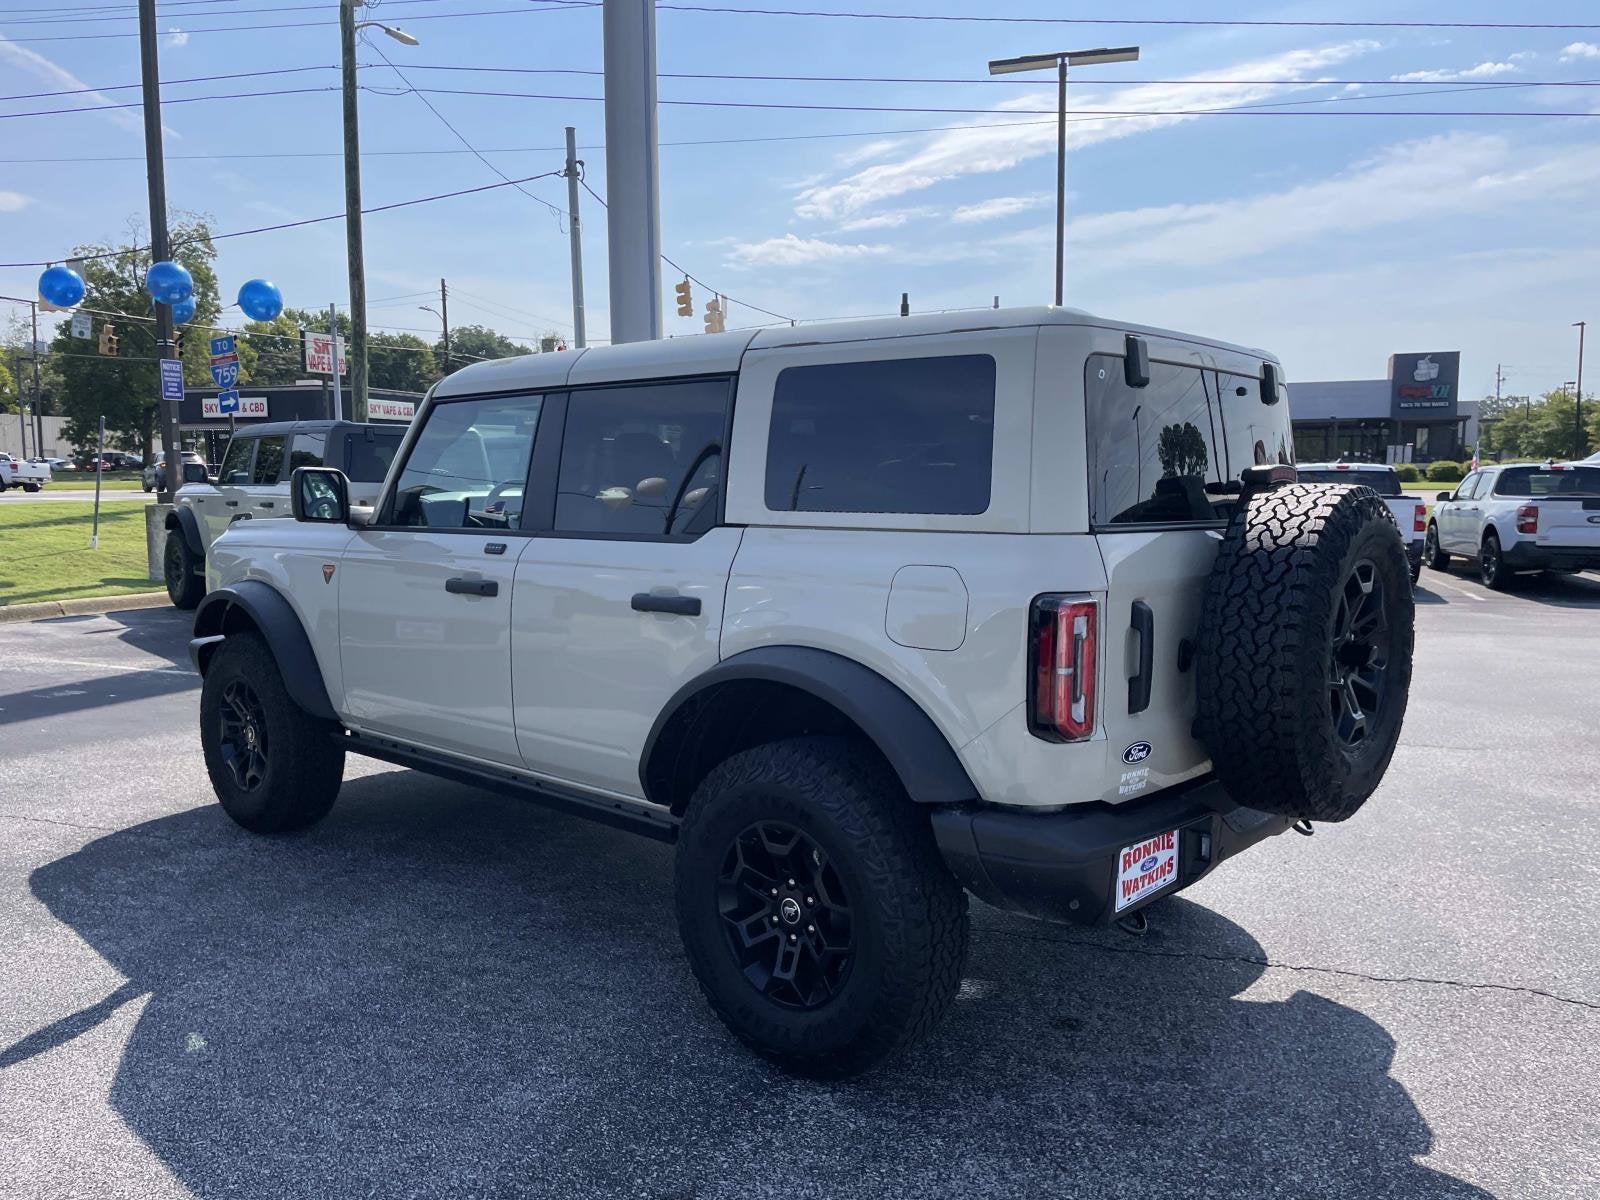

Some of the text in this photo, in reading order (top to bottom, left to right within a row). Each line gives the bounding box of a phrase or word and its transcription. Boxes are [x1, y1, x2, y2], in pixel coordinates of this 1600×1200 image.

[216, 340, 228, 351] TO
[162, 363, 181, 371] NOTICE
[307, 354, 326, 371] VAPE
[215, 366, 237, 384] 759
[204, 403, 265, 413] SKY & CBD
[370, 404, 414, 416] SKY VAPE & CBD
[1128, 745, 1149, 762] Ford
[1122, 831, 1174, 874] RONNIE
[1122, 855, 1174, 898] WATKINS
